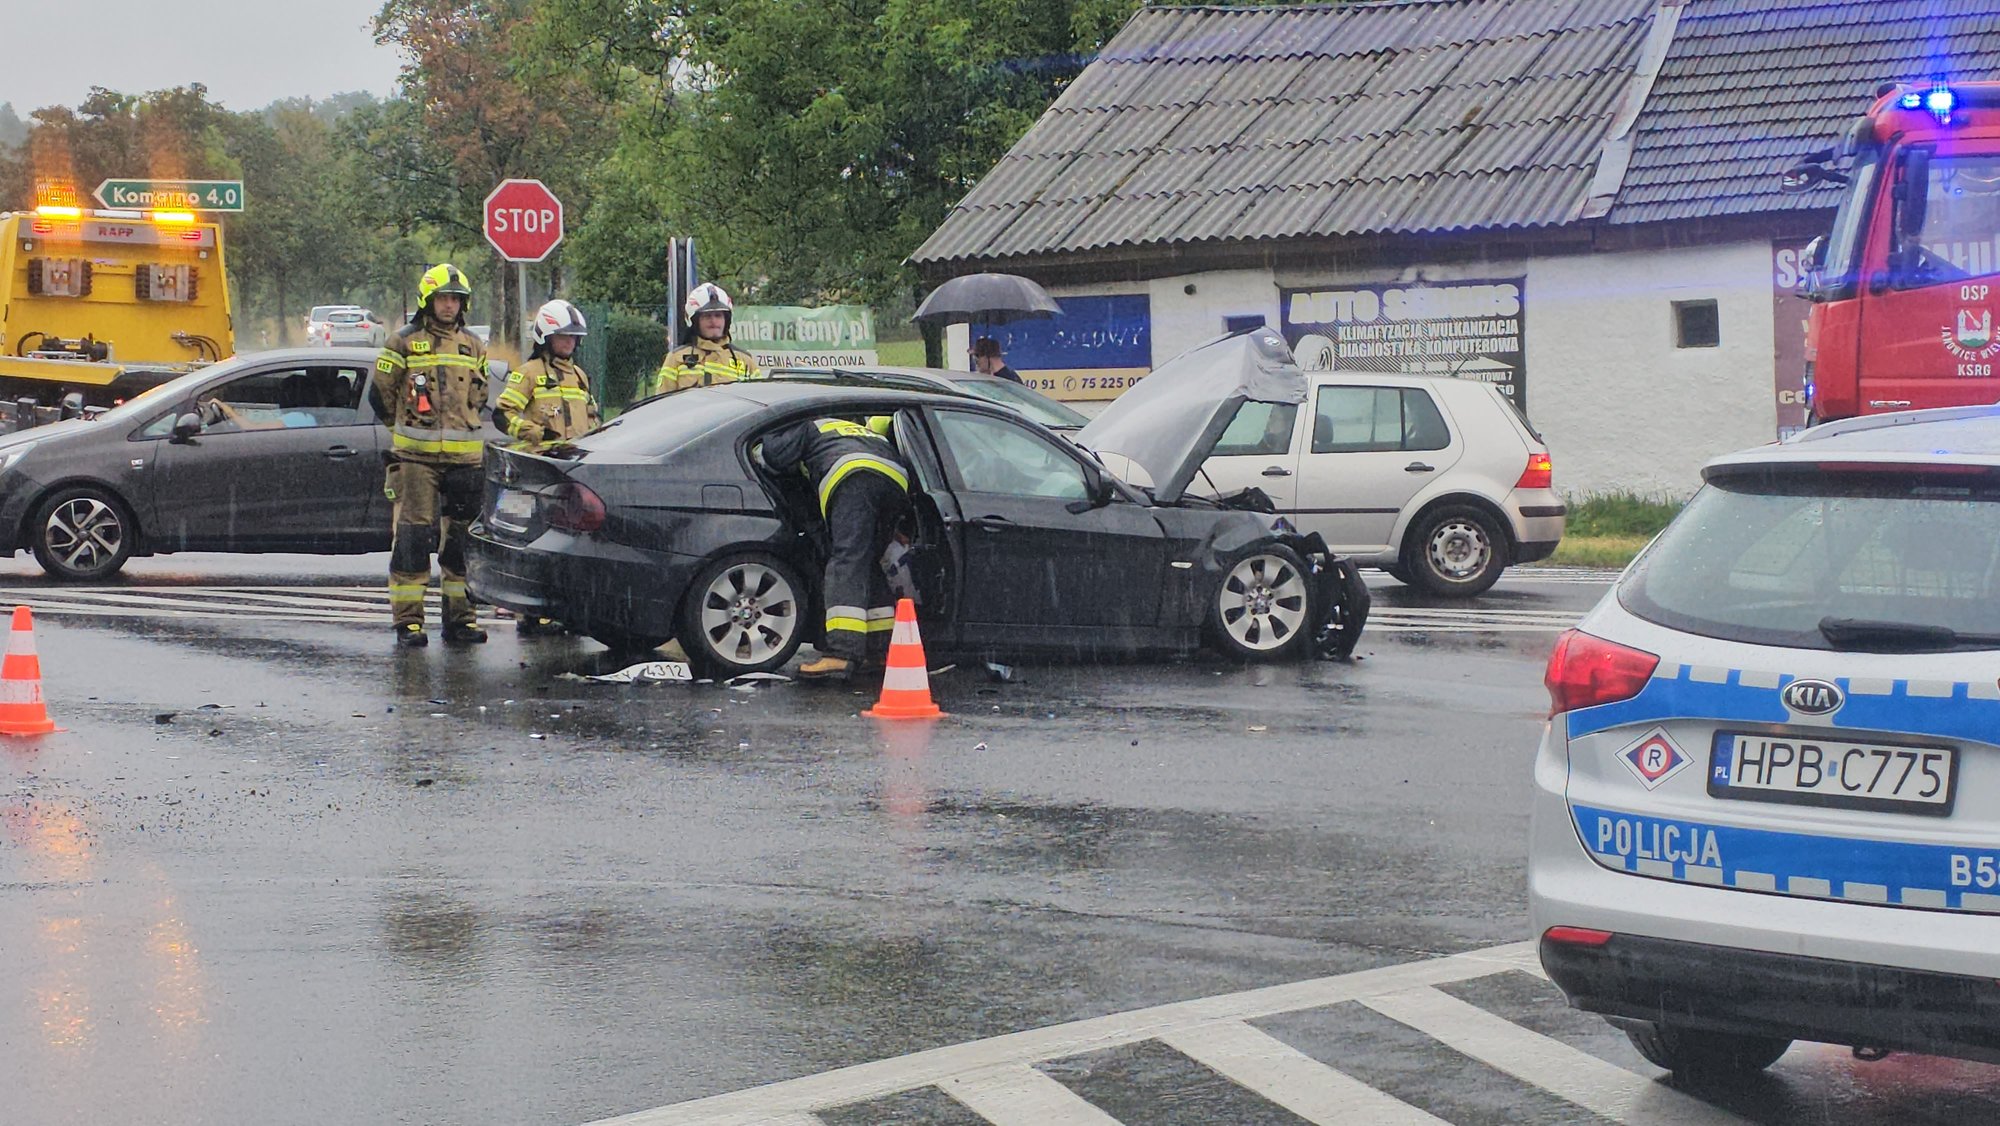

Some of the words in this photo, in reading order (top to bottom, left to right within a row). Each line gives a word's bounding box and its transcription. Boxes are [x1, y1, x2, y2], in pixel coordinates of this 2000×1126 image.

[207, 188, 237, 206] 4,0
[494, 208, 555, 234] STOP
[98, 226, 134, 238] RAPP
[1961, 285, 1989, 300] OSP
[1288, 290, 1380, 324] AUTO
[731, 312, 870, 347] emianatony.pl
[1338, 323, 1423, 341] KLIMATYZACJA
[1427, 319, 1519, 338] WULKANIZACJA
[1338, 341, 1422, 359] DIAGNOSTYKA
[1425, 337, 1519, 356] KOMPUTEROWA
[757, 355, 793, 368] ZIEMIA
[1958, 364, 1991, 376] KSRG
[1041, 379, 1056, 390] 91
[1082, 378, 1097, 389] 75
[1100, 378, 1124, 389] 225
[1791, 686, 1831, 708] KIA
[1647, 749, 1662, 768] R
[1715, 766, 1729, 780] PL
[1737, 740, 1823, 788] HPB
[1841, 748, 1943, 798] C775
[1597, 816, 1723, 868] POLICJA
[1951, 854, 2000, 888] B5
